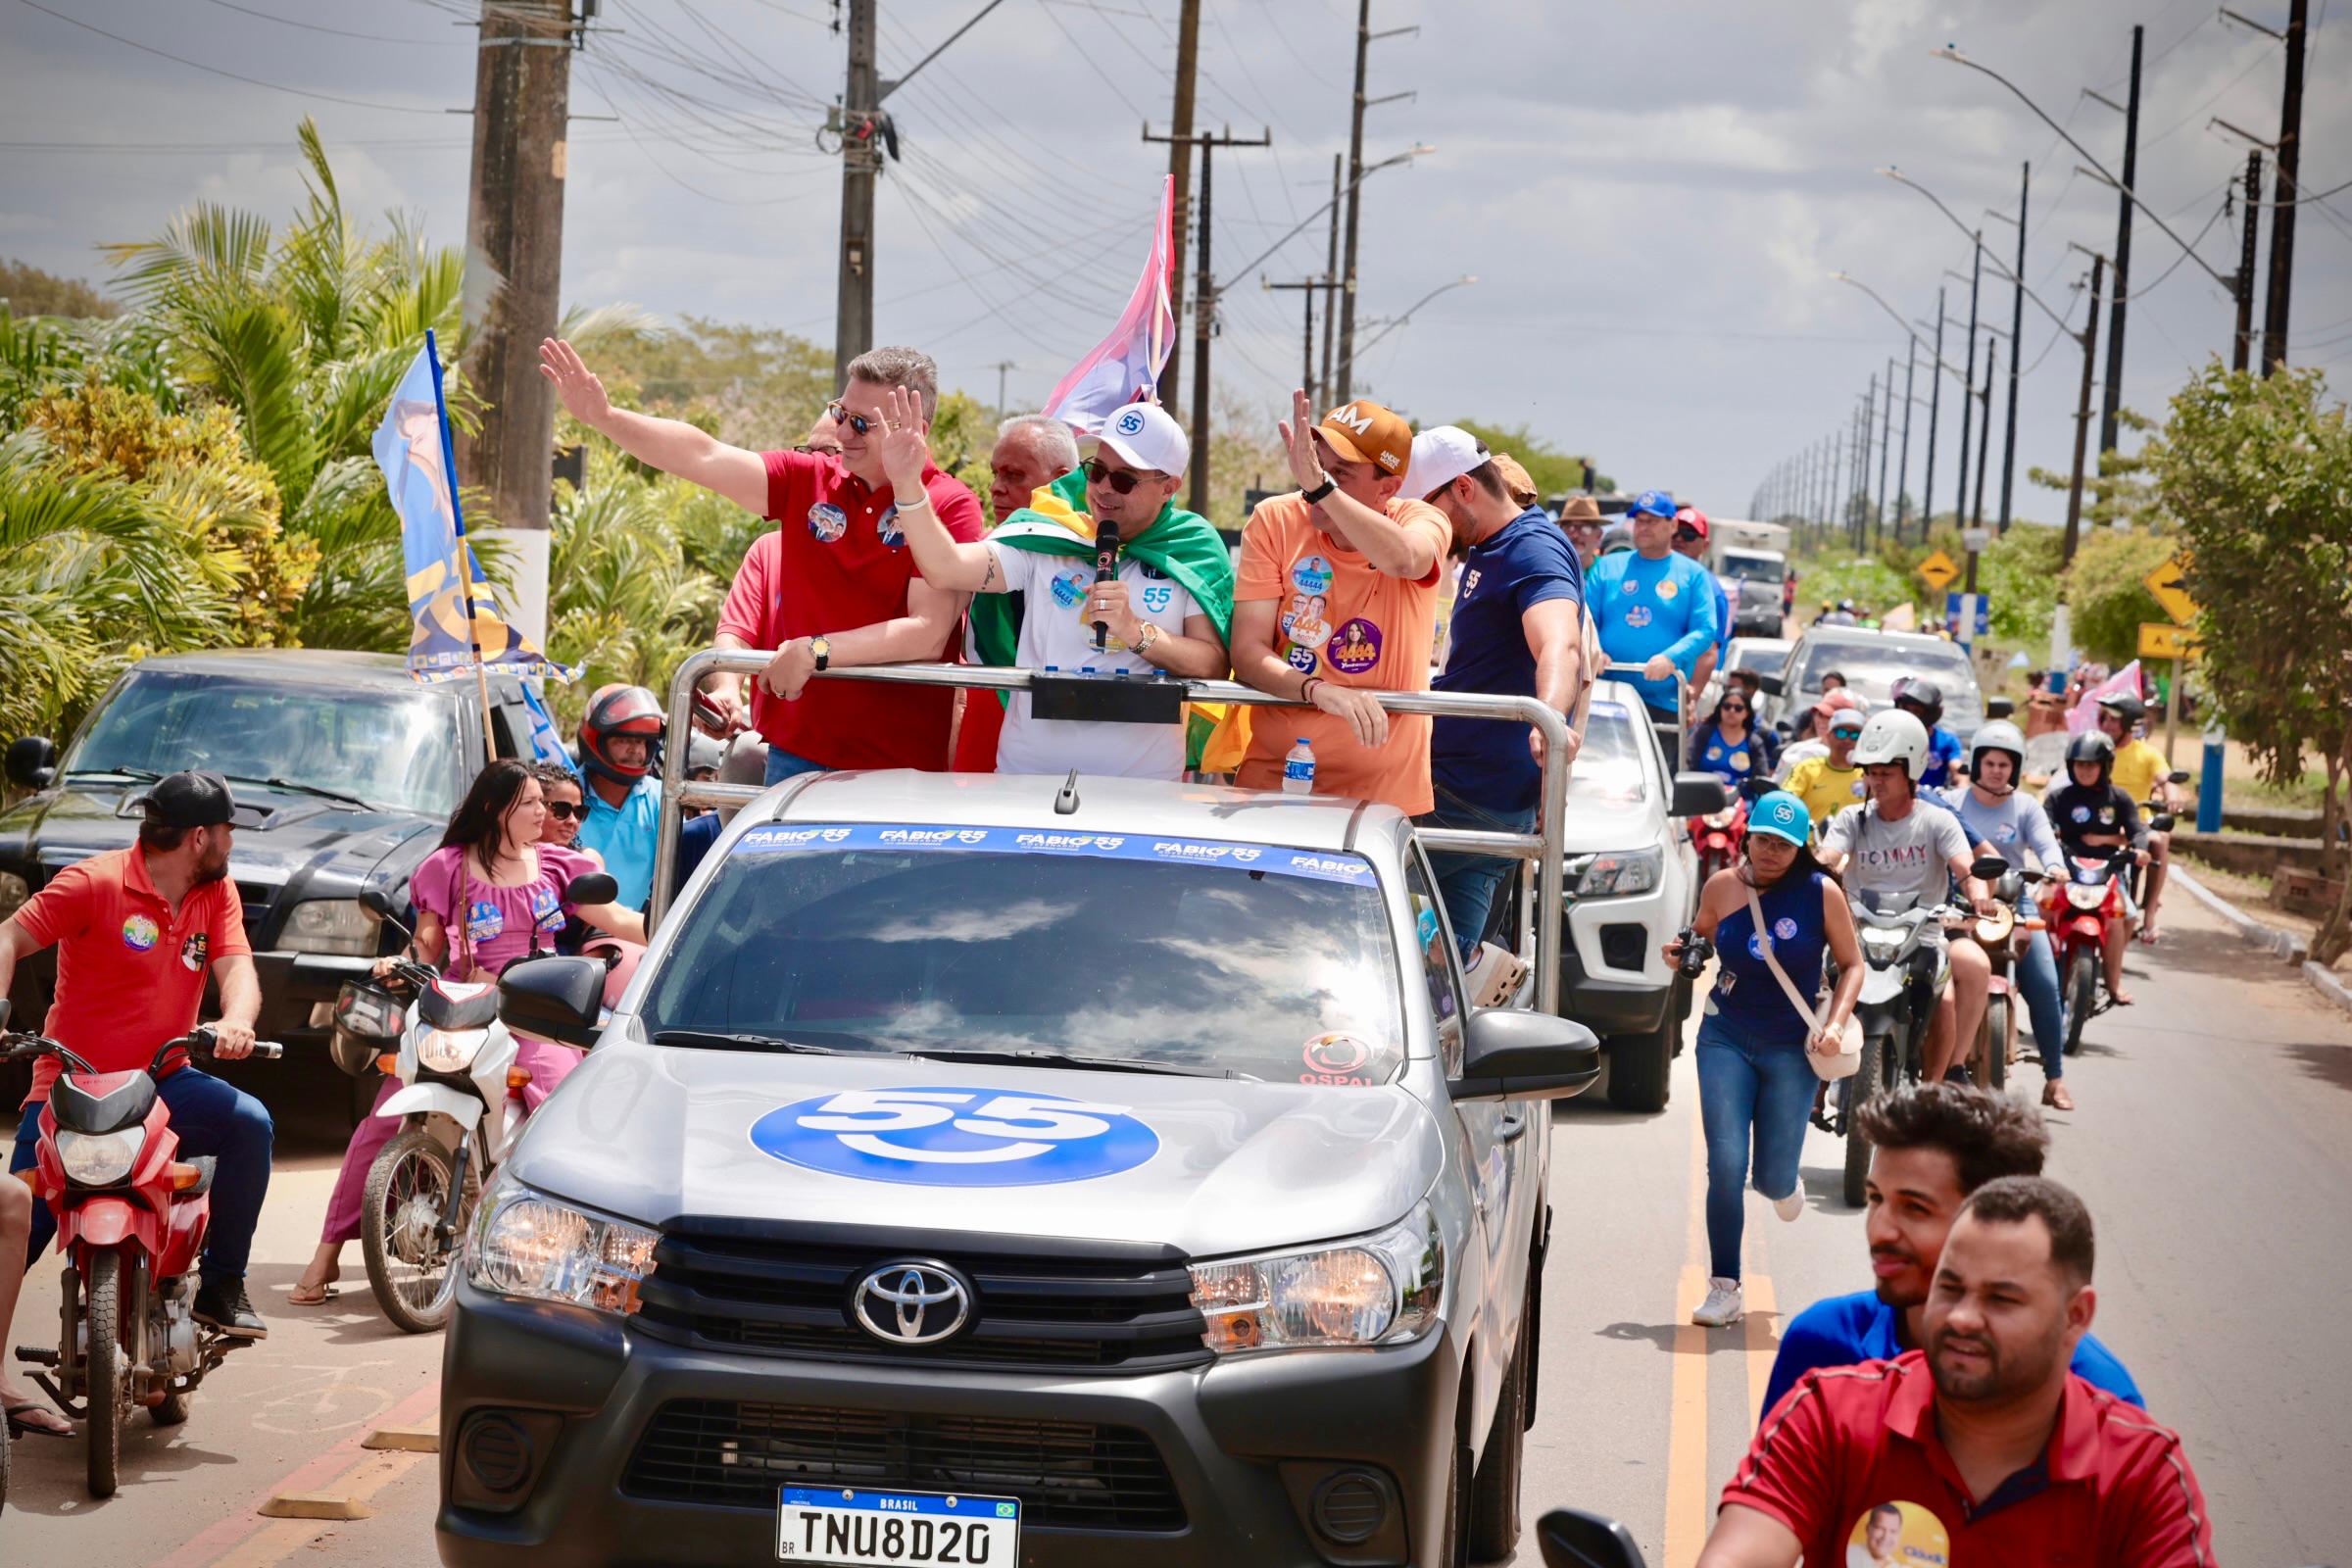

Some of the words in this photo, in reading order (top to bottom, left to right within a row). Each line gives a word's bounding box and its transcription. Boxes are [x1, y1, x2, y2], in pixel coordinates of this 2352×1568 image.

[1119, 416, 1141, 431] 55
[1328, 405, 1374, 436] AM
[1143, 587, 1172, 604] 55
[1289, 647, 1314, 663] 55
[1776, 808, 1792, 820] 55
[821, 828, 853, 838] 55
[956, 830, 988, 840] 55
[1094, 836, 1126, 846] 55
[1232, 847, 1262, 858] 55
[1857, 844, 1927, 864] TOMMY
[796, 1090, 1133, 1141] 55
[880, 1498, 918, 1511] BRASIL
[800, 1511, 990, 1565] TNU8D20
[782, 1541, 795, 1554] BR
